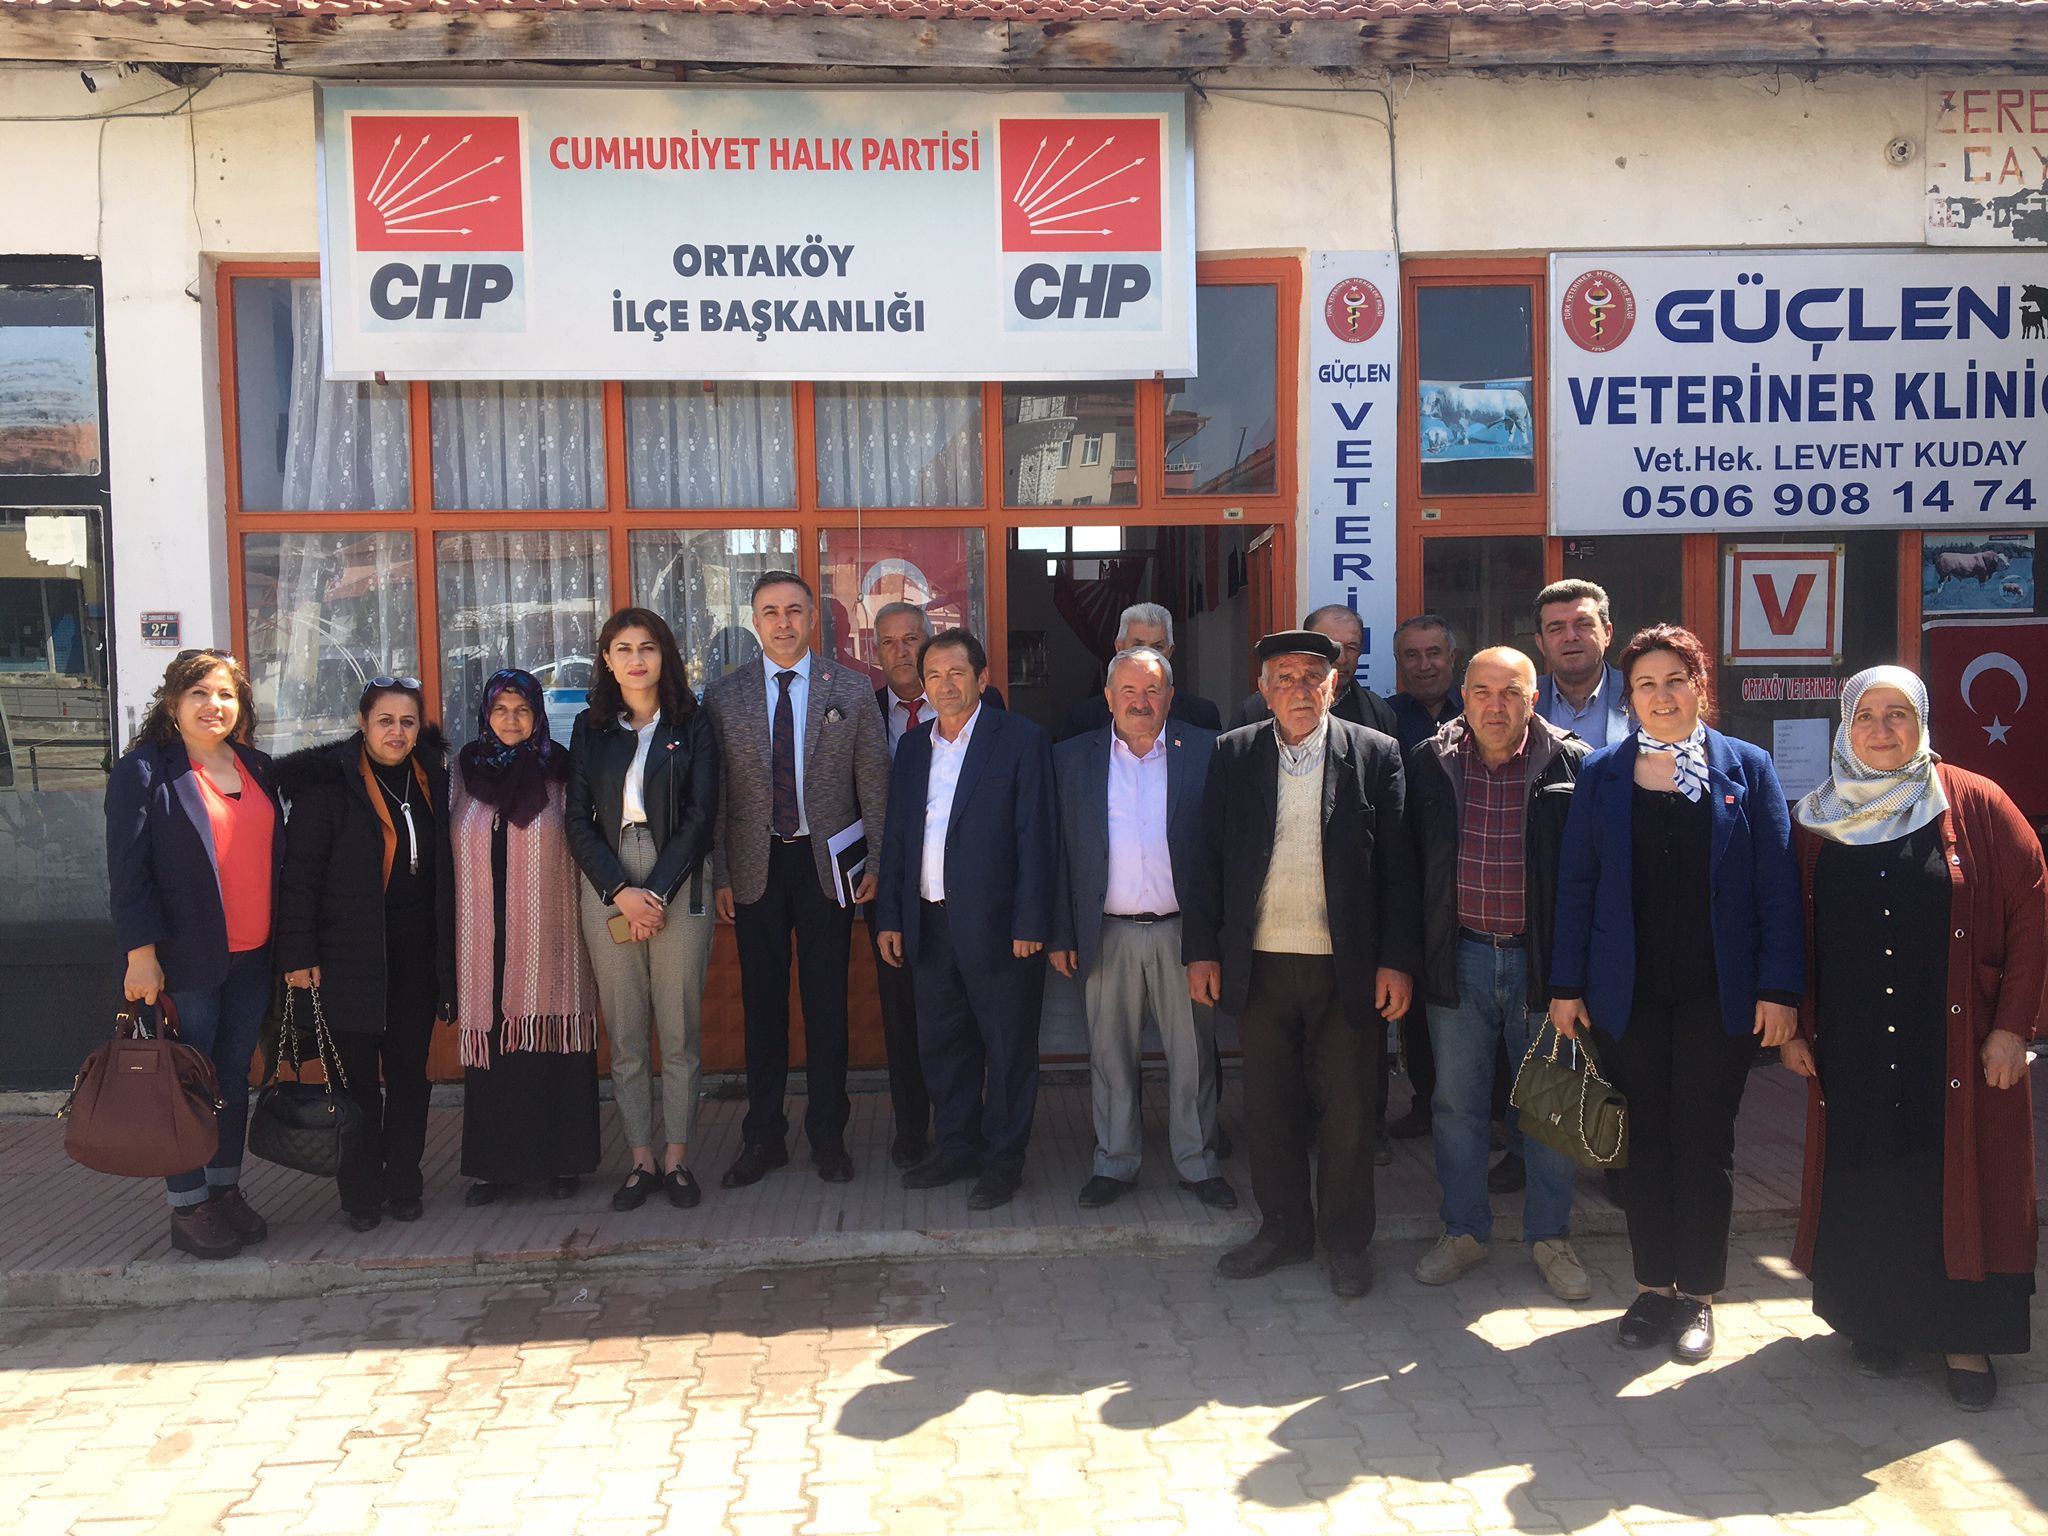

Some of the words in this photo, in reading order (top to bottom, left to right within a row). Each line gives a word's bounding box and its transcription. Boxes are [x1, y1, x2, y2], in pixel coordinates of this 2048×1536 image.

[549, 129, 761, 171] CUMHURİYET
[769, 137, 853, 171] HALK
[861, 131, 980, 171] PARTİSİ
[672, 234, 855, 277] ORTAKÖY
[370, 262, 514, 320] CHP
[1014, 262, 1152, 320] CHP
[612, 289, 690, 341] İLÇE
[700, 291, 925, 341] BAŞKANLIĞI
[1655, 272, 2011, 362] GÜÇLEN
[1318, 358, 1391, 390] GÜÇLEN
[1567, 356, 1876, 426] VETERİNER
[1894, 357, 2048, 421] KLİNİ
[1633, 445, 1762, 473] Vet.Hek.
[1775, 442, 1904, 471] LEVENT
[1914, 439, 2028, 468] KUDAY
[1622, 484, 1754, 519] 0506
[1773, 482, 1871, 517] 908
[1892, 480, 1955, 514] 14
[1973, 478, 2037, 512] 74
[1752, 573, 1817, 636] V
[151, 623, 169, 637] 27
[1742, 673, 1785, 701] ORTAKÖY
